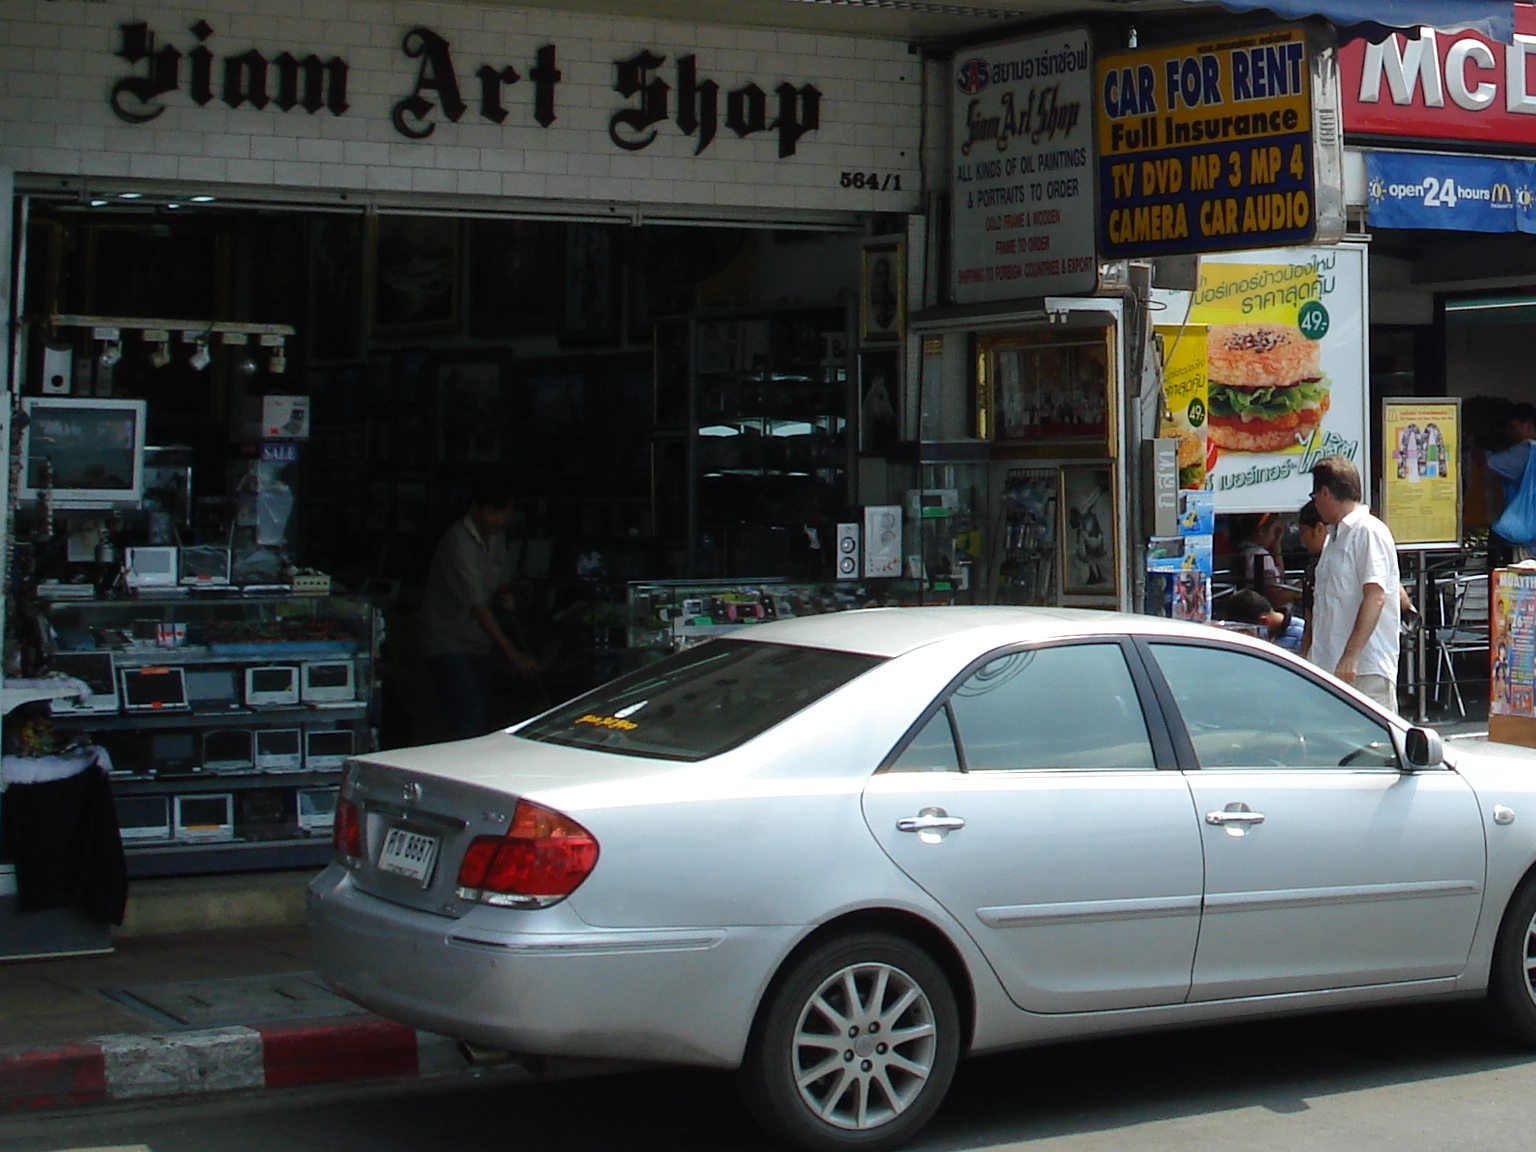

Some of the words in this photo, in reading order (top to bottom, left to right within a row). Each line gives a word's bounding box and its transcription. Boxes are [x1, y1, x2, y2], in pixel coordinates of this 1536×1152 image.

[110, 20, 350, 124] Siam
[392, 24, 562, 139] Art
[609, 49, 823, 158] Shop
[1103, 64, 1159, 120] CAR
[1164, 53, 1224, 110] FOR
[1230, 41, 1305, 103] RENT
[997, 88, 1036, 152] Art
[1031, 81, 1081, 145] Shop
[1111, 118, 1157, 151] Full
[1165, 109, 1298, 144] Insurance
[957, 165, 973, 182] ALL
[976, 159, 1001, 180] KINDS
[1005, 157, 1018, 176] OF
[1021, 156, 1036, 175] OIL
[1038, 147, 1087, 172] PAINTINGS
[1111, 162, 1136, 199] TV
[1142, 157, 1184, 196] DVD
[1190, 152, 1221, 192] MP
[1228, 150, 1242, 188] 3
[1250, 146, 1283, 185] MP
[1289, 143, 1305, 181] 4
[840, 171, 902, 192] 564/1
[977, 184, 1025, 207] PORTRAITS
[1030, 183, 1042, 201] TO
[1047, 178, 1079, 200] ORDER
[1389, 182, 1424, 199] open
[1423, 177, 1457, 208] 24
[1457, 185, 1490, 200] hours
[1033, 209, 1061, 225] WOODEN
[1108, 202, 1189, 244] CAMERA
[1200, 198, 1239, 237] CAR
[1241, 189, 1310, 233] AUDIO
[1028, 235, 1050, 252] ORDER
[1067, 256, 1093, 274] EXPORT
[263, 445, 295, 460] SALE
